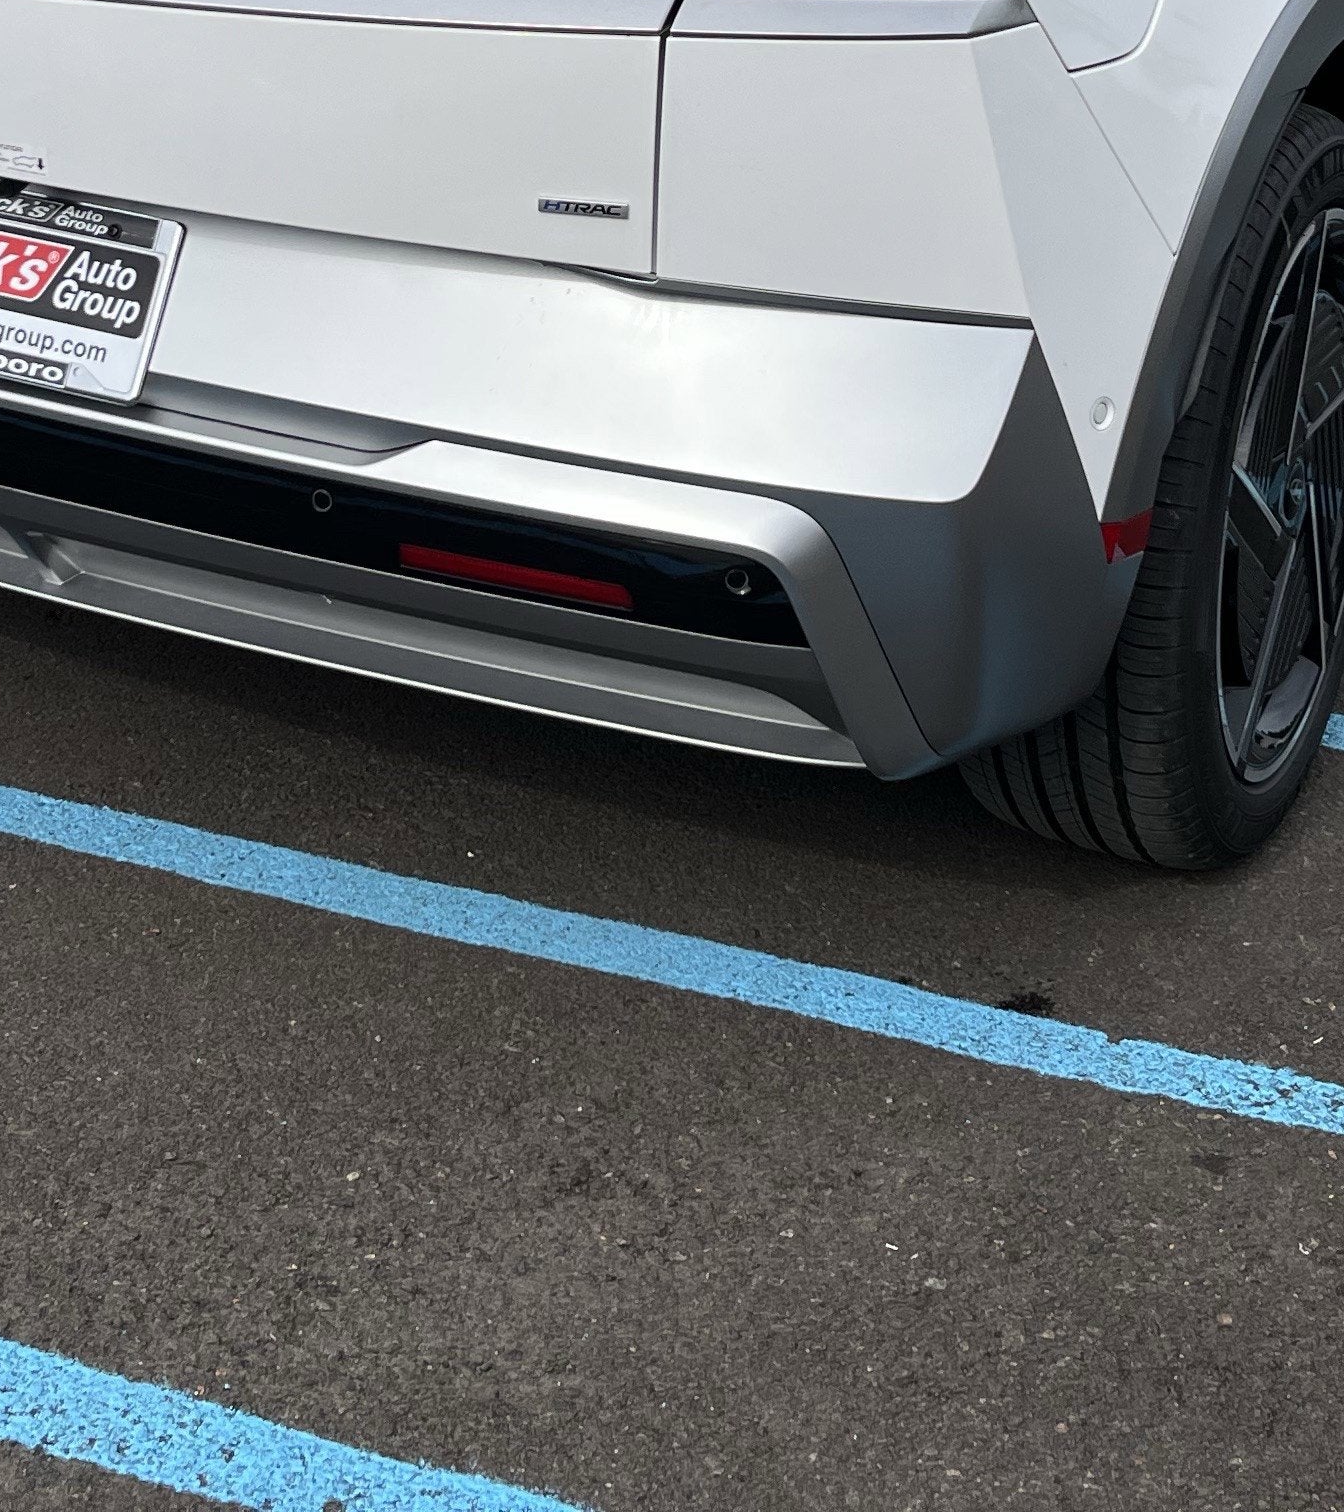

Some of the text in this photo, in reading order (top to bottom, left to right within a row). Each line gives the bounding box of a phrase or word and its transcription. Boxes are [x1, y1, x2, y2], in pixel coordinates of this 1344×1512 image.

[61, 205, 104, 223] Auto
[543, 199, 622, 217] HTRAC
[54, 214, 109, 236] Group
[63, 251, 137, 291] Auto
[52, 278, 141, 328] Group
